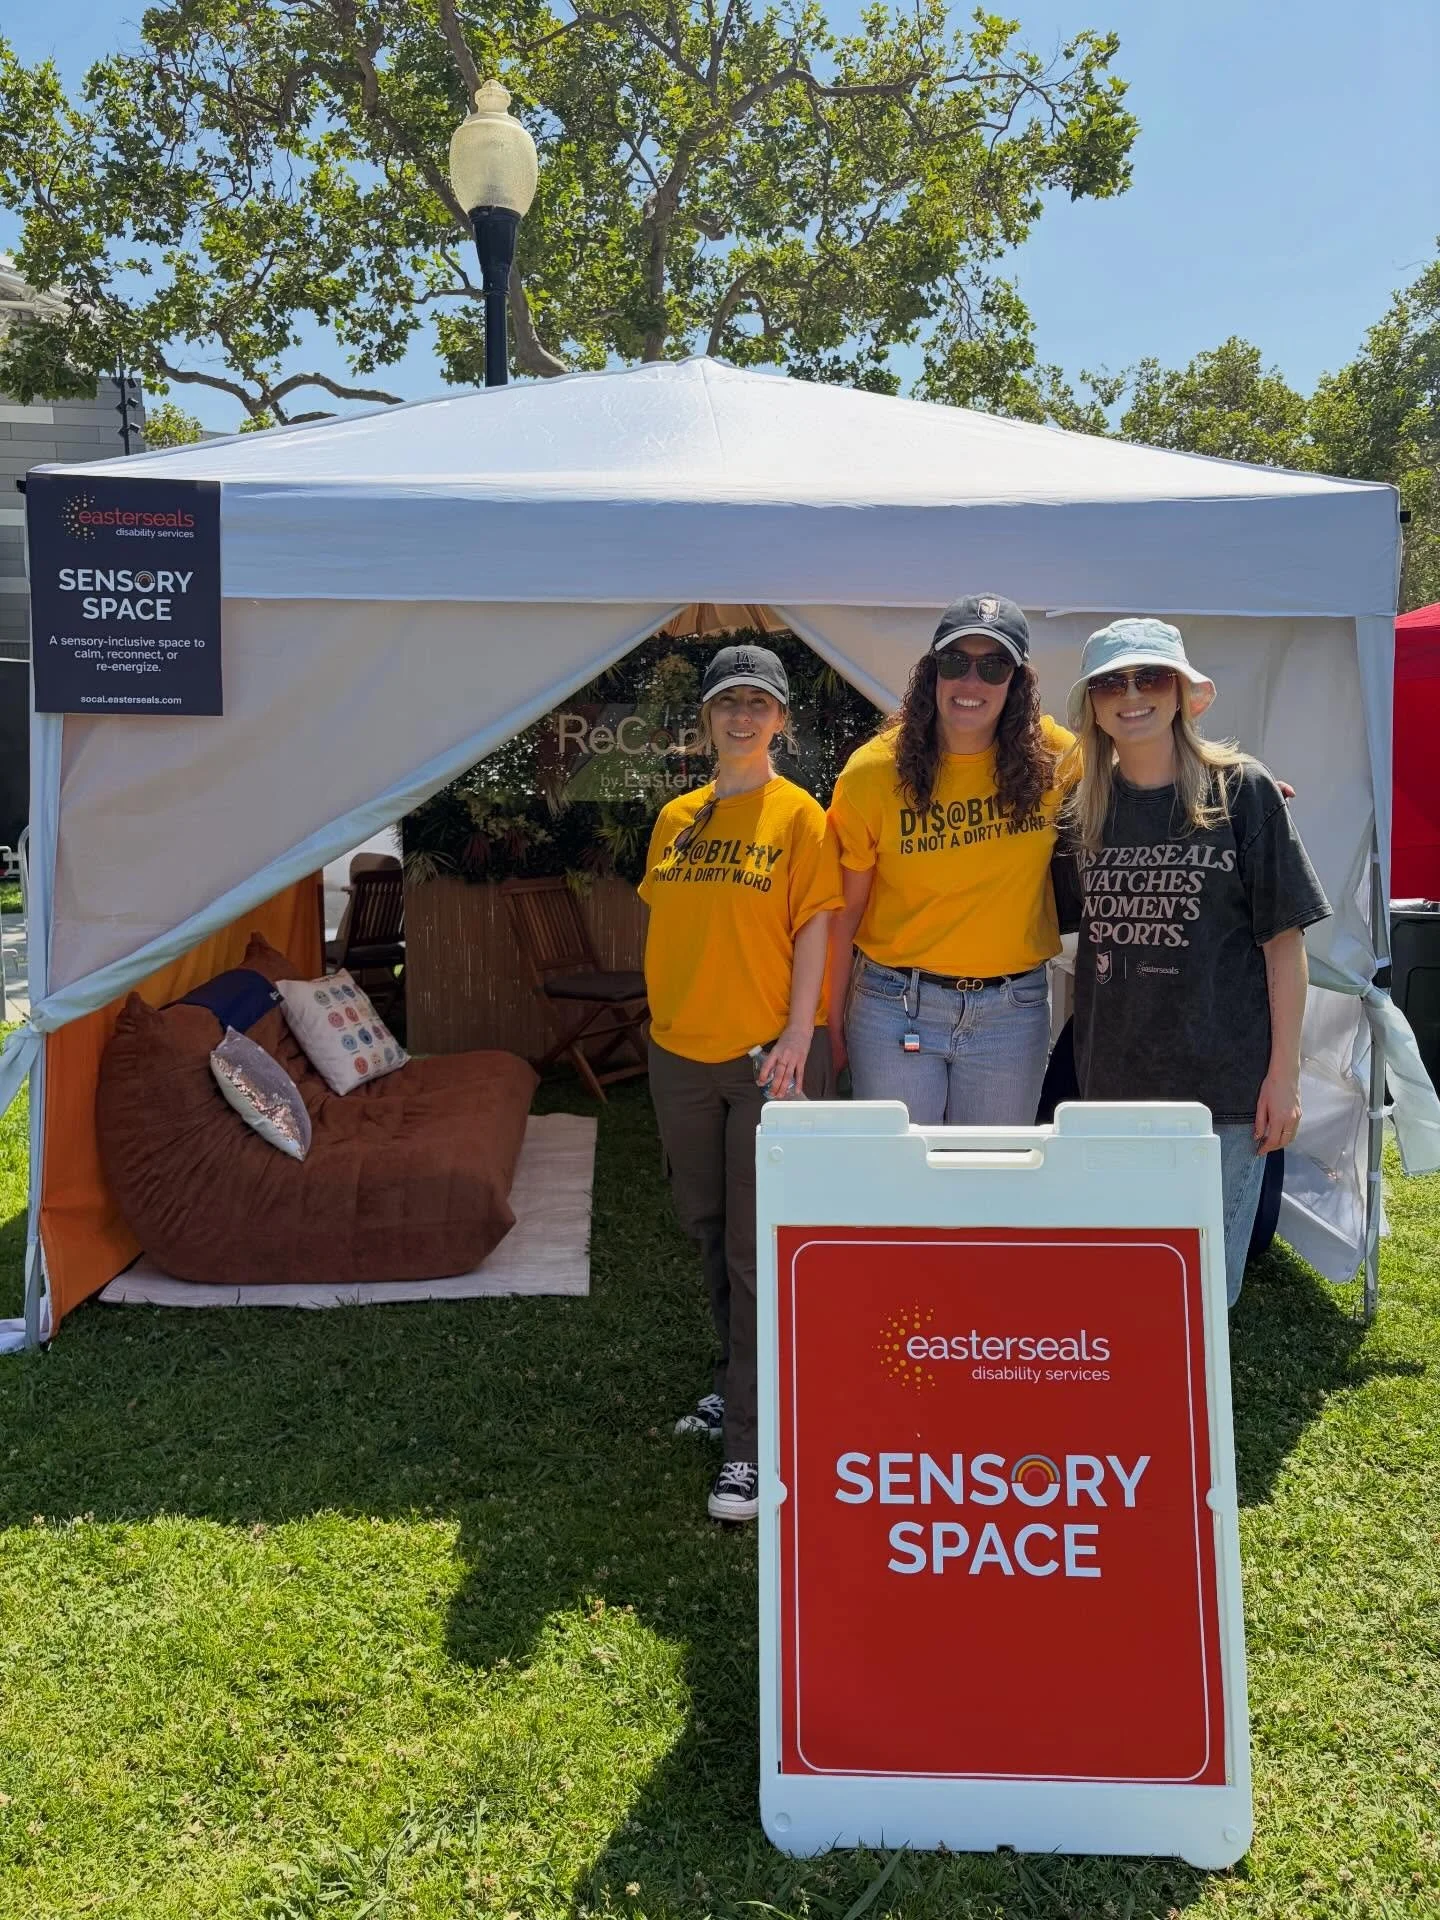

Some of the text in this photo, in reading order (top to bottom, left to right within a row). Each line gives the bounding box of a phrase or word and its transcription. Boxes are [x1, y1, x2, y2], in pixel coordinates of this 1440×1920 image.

[79, 507, 194, 527] easterseals
[116, 528, 194, 539] disability services
[58, 568, 194, 593] SENSORY
[82, 597, 172, 621] SPACE
[49, 636, 206, 649] A sensory-inclusive space to
[74, 649, 178, 661] calm, reconnect, or
[96, 661, 162, 673] re-energize.
[81, 695, 182, 705] socal.easterseals.com
[600, 773, 619, 789] by
[900, 839, 914, 854] IS
[918, 834, 946, 852] NOT
[950, 835, 960, 848] A
[964, 823, 1002, 845] DIRTY
[683, 868, 694, 882] A
[695, 868, 730, 882] DIRTY
[732, 868, 772, 893] WORD
[1089, 921, 1190, 948] SPORTS.
[906, 1329, 1111, 1361] easterseals
[971, 1366, 1111, 1384] disability services
[835, 1452, 1151, 1507] SENSORY
[887, 1521, 1102, 1578] SPACE
